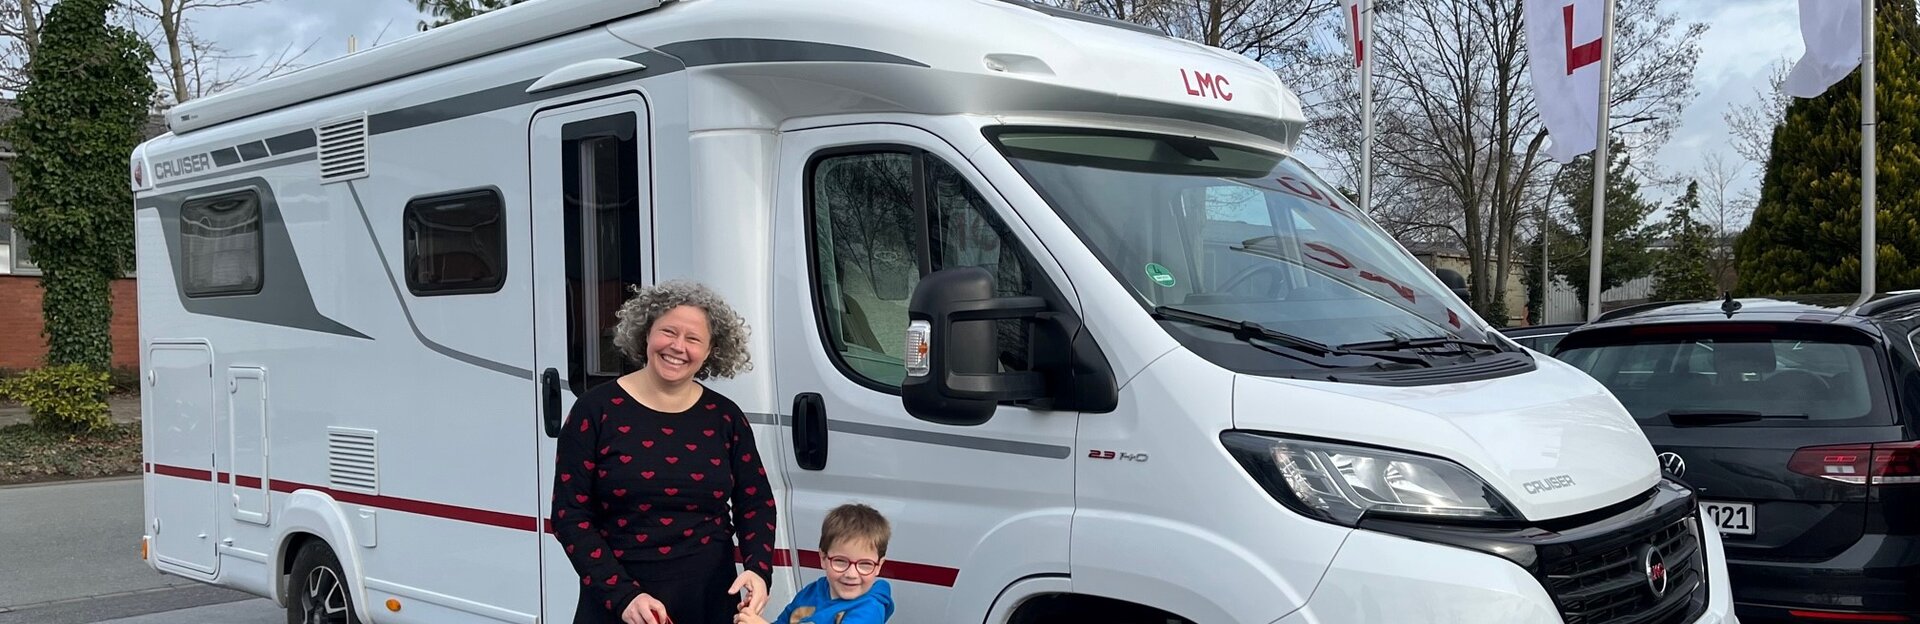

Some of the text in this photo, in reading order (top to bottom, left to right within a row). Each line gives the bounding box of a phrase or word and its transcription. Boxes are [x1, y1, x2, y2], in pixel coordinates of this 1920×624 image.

[1180, 68, 1233, 102] LMC
[154, 152, 211, 180] CRUISER
[1522, 474, 1576, 495] CRUISER
[1707, 505, 1749, 530] 021
